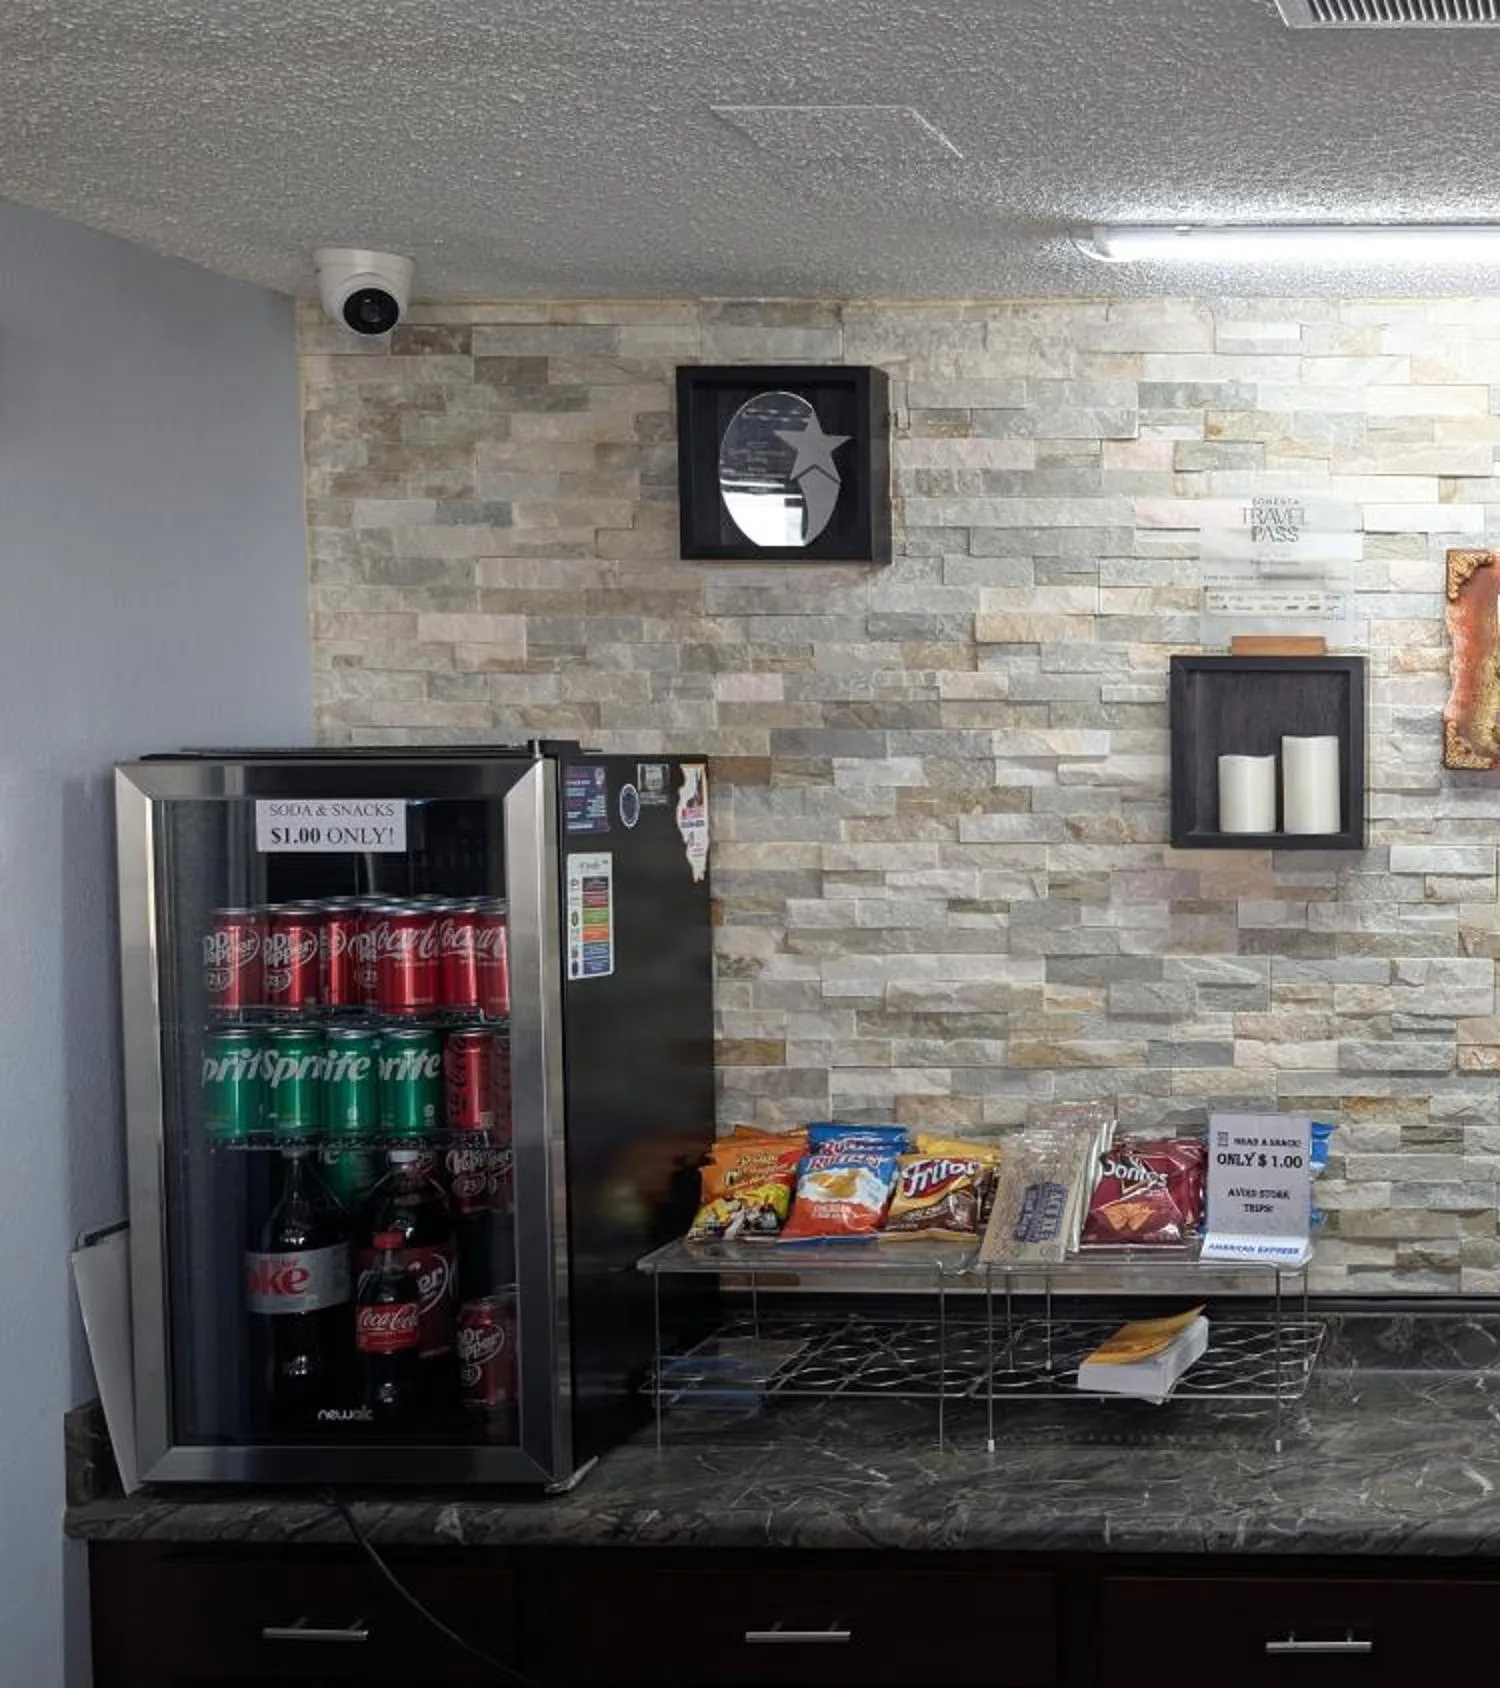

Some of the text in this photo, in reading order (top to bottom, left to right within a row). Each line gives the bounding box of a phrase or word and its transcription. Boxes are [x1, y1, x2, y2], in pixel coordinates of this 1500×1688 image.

[1242, 507, 1306, 525] TRAVEL
[1251, 526, 1299, 543] PASS
[270, 804, 394, 817] SODA & SNACKS
[271, 826, 394, 845] $1.00 ONLY!
[1217, 1152, 1303, 1168] ONLY $ 1.00
